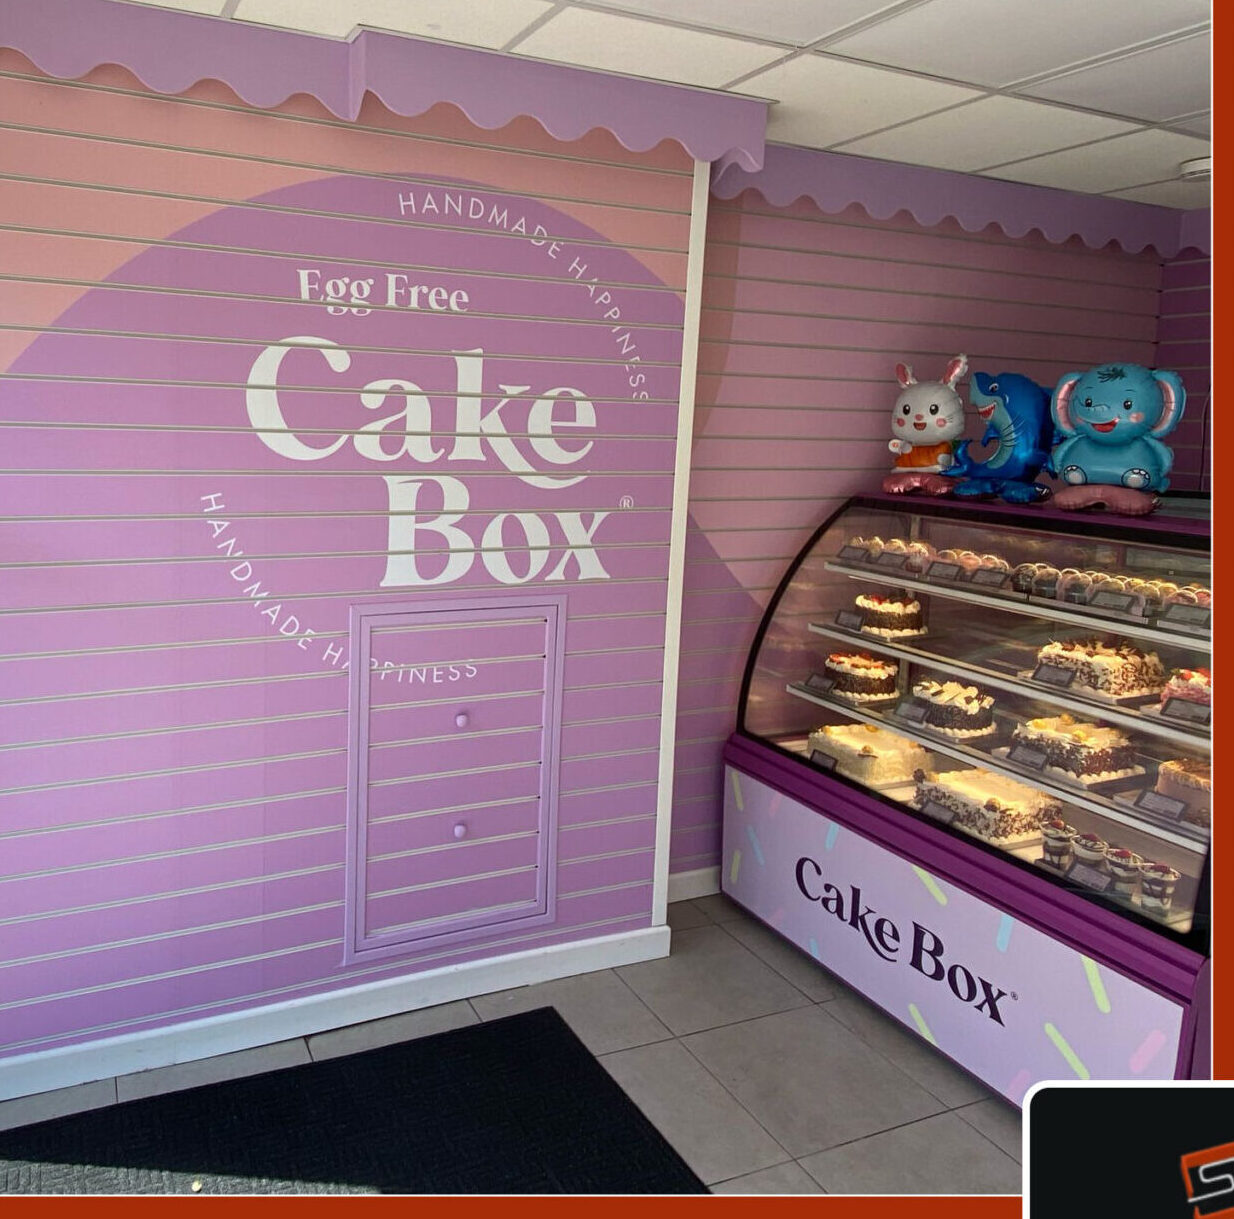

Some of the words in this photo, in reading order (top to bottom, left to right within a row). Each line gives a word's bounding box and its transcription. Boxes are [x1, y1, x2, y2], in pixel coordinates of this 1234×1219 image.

[296, 268, 374, 316] Egg
[386, 273, 470, 313] Free
[398, 191, 563, 260] HANDMADE
[567, 256, 649, 402] HAPPINESS
[245, 336, 597, 490] Cake
[200, 491, 316, 650] HANDMADE
[795, 856, 901, 963] Cake
